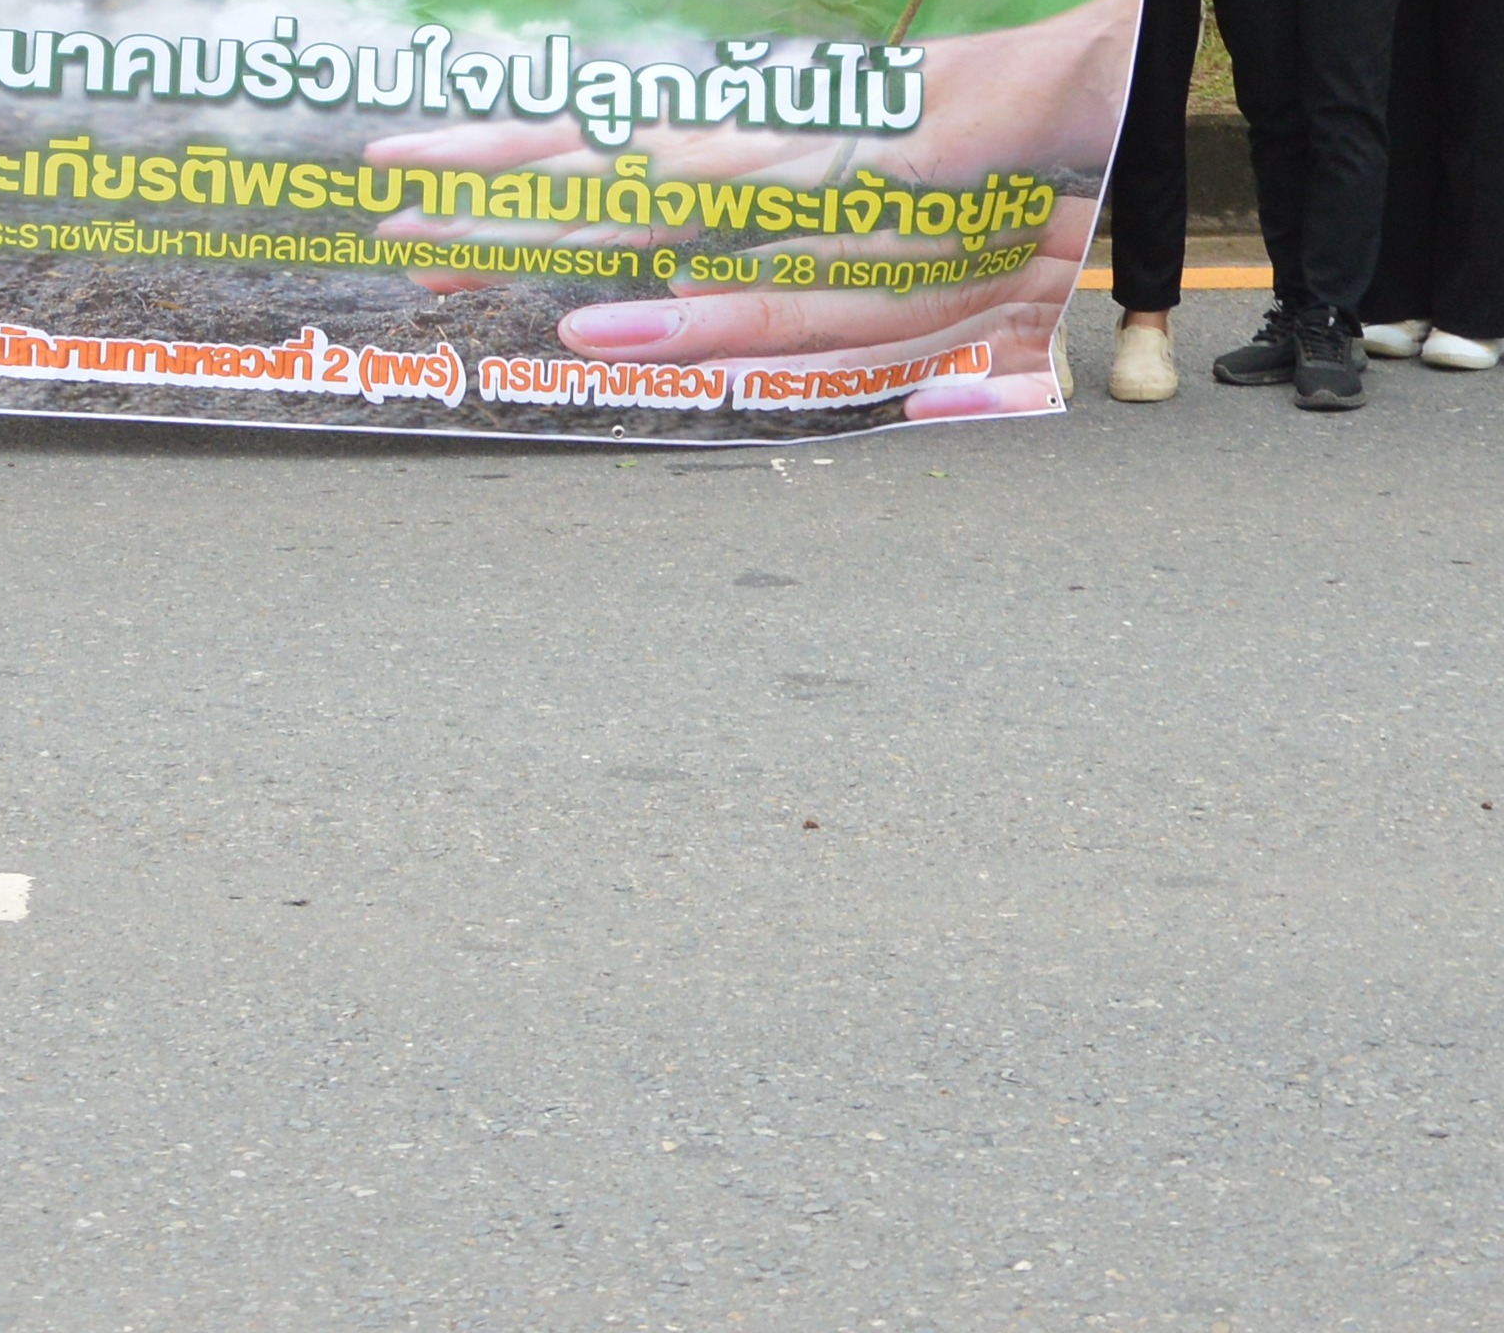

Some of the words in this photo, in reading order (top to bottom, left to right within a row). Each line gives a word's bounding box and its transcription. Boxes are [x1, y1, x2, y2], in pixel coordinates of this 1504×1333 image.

[651, 248, 678, 279] 6
[690, 253, 760, 284] รอบ
[771, 254, 816, 286] 28
[828, 256, 968, 294] กรกฎาคม
[971, 242, 1038, 281] 2567
[321, 346, 350, 384] 2
[357, 344, 464, 399] (แพร่)
[480, 357, 727, 403] กรมทางหลวง
[741, 341, 992, 402] กระทรวงคมนาคม
